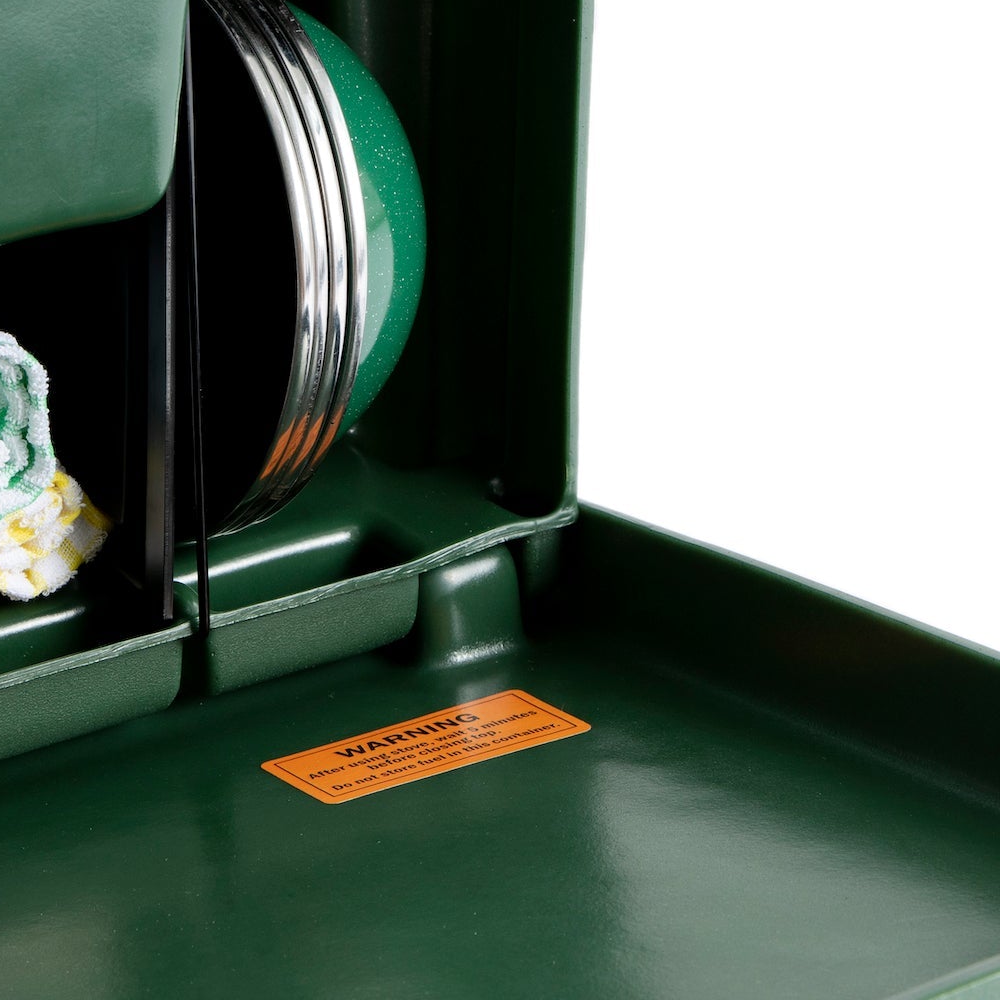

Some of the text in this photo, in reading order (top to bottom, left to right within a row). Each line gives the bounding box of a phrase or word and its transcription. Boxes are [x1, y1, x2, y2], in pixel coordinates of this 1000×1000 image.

[308, 765, 349, 780] After
[348, 752, 391, 769] using
[390, 741, 435, 755] stove,
[434, 729, 466, 742] wait
[481, 710, 537, 730] minutes
[331, 723, 561, 791] Do not store fuel in this container.
[335, 713, 480, 758] WARNING
[366, 730, 502, 771] before closing top.
